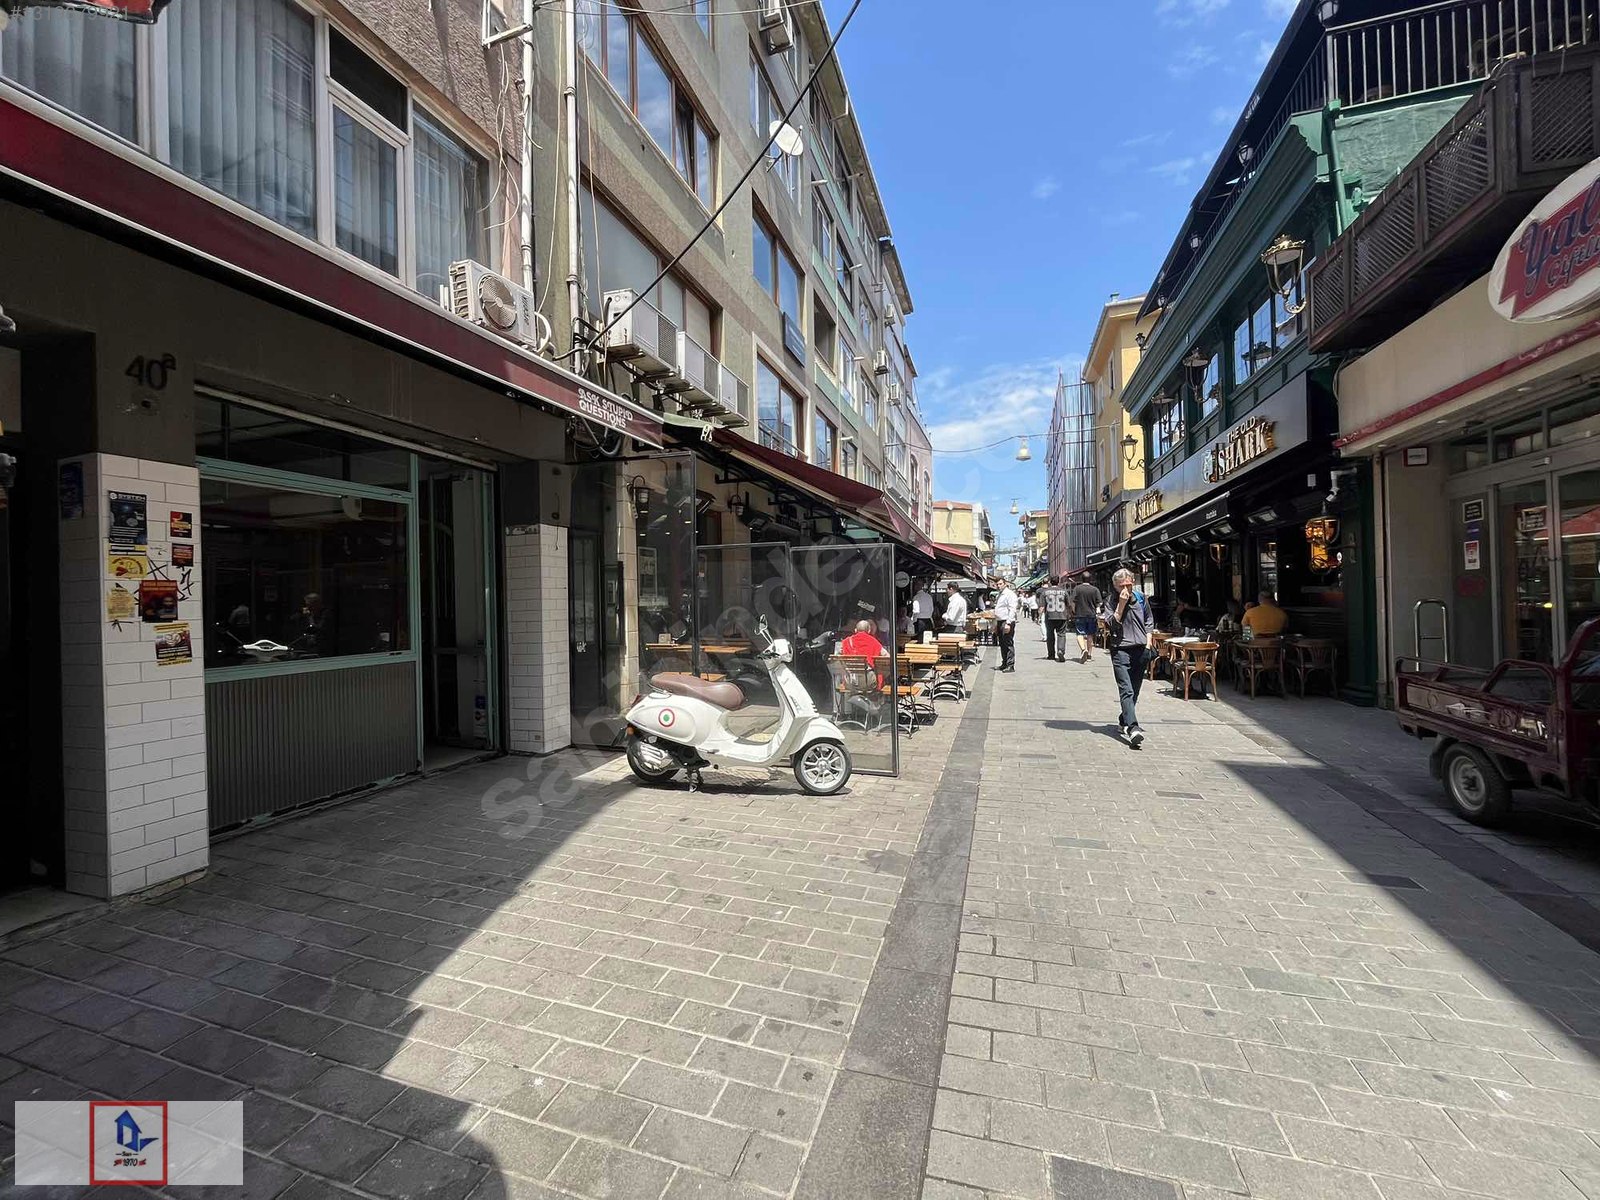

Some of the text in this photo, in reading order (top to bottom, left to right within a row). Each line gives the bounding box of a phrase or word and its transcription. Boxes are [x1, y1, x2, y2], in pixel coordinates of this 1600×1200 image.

[578, 388, 633, 421] ASK STUPID
[579, 400, 627, 428] QUESTIONS
[1227, 415, 1256, 443] THE OLD
[1218, 422, 1269, 476] SHARK
[1046, 595, 1066, 613] 86
